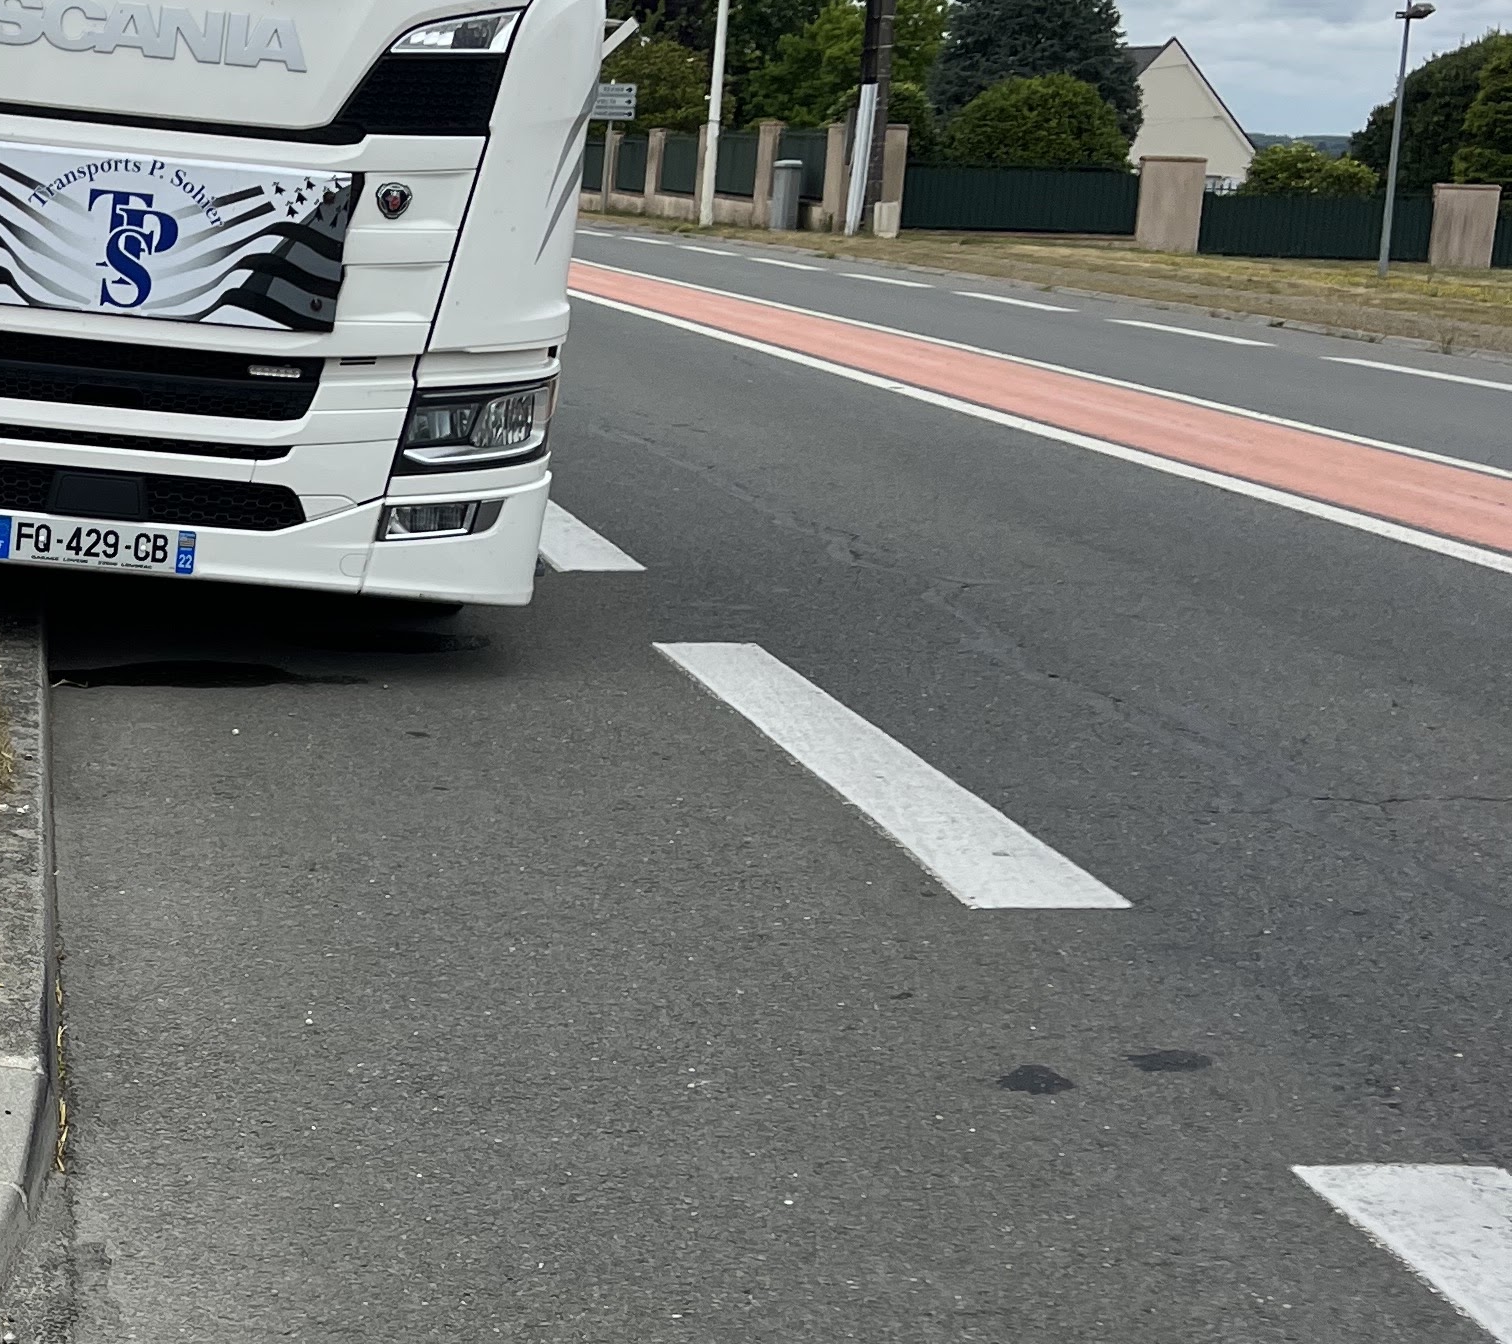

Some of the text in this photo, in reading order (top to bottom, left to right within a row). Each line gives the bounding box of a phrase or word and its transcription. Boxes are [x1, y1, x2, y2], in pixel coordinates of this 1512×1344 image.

[28, 158, 224, 227] Transports P. Sohier
[15, 522, 168, 563] FQ-429-CB
[178, 554, 193, 568] 22
